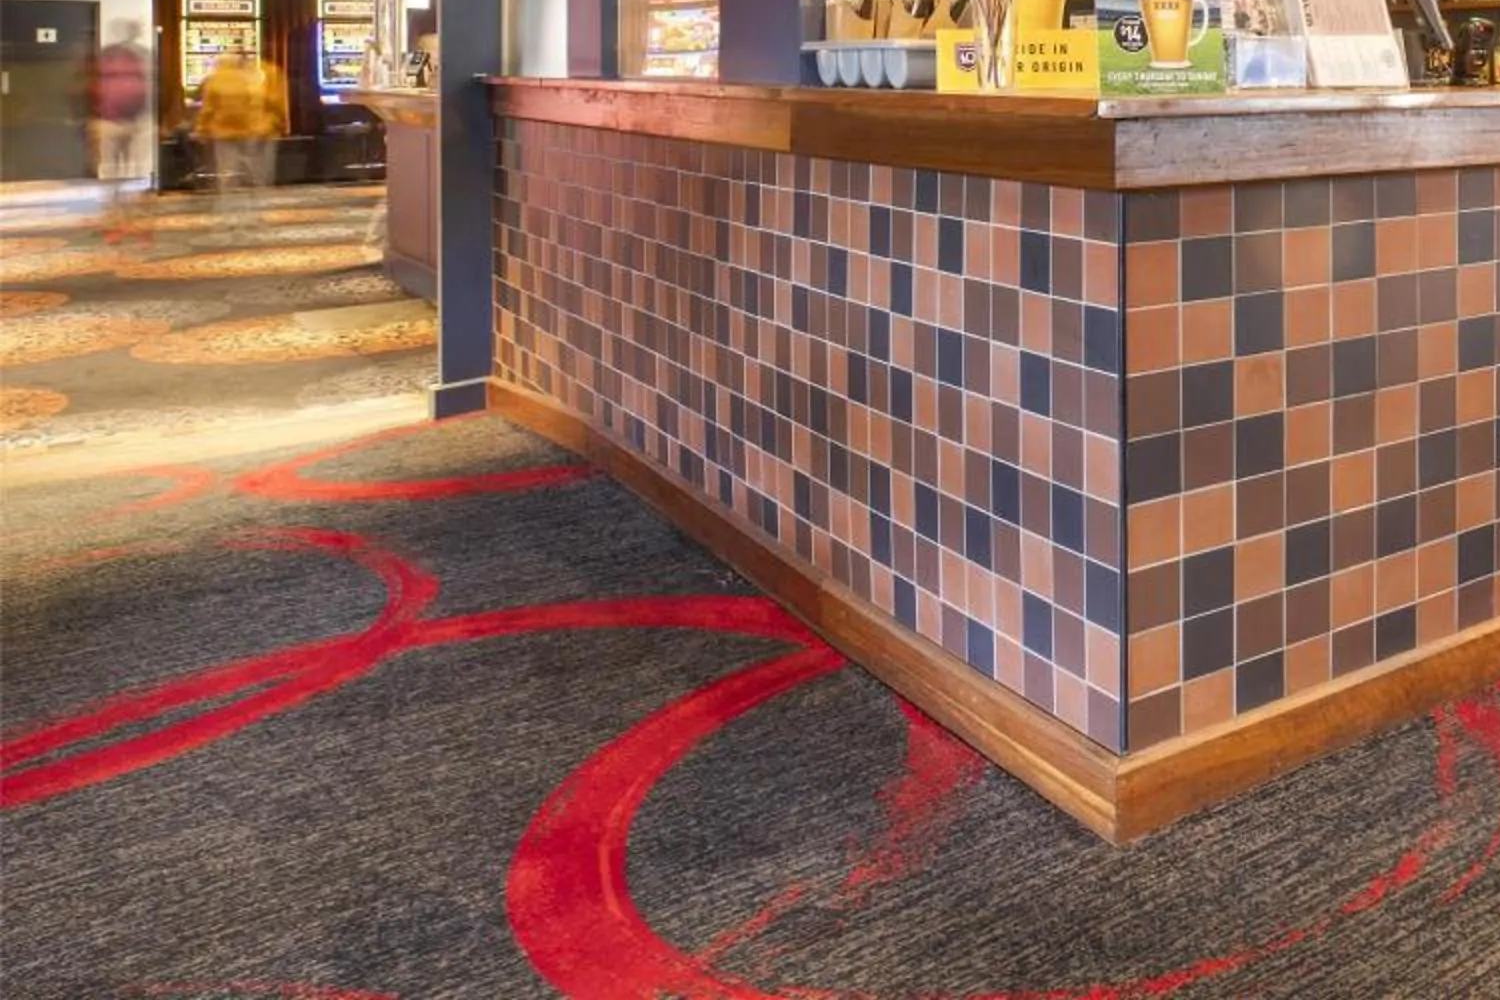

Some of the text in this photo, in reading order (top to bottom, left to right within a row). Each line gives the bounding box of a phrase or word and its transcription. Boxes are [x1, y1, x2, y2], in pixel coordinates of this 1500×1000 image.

[1120, 25, 1141, 40] $14
[1053, 43, 1068, 55] IN
[1031, 61, 1084, 73] ORIGIN
